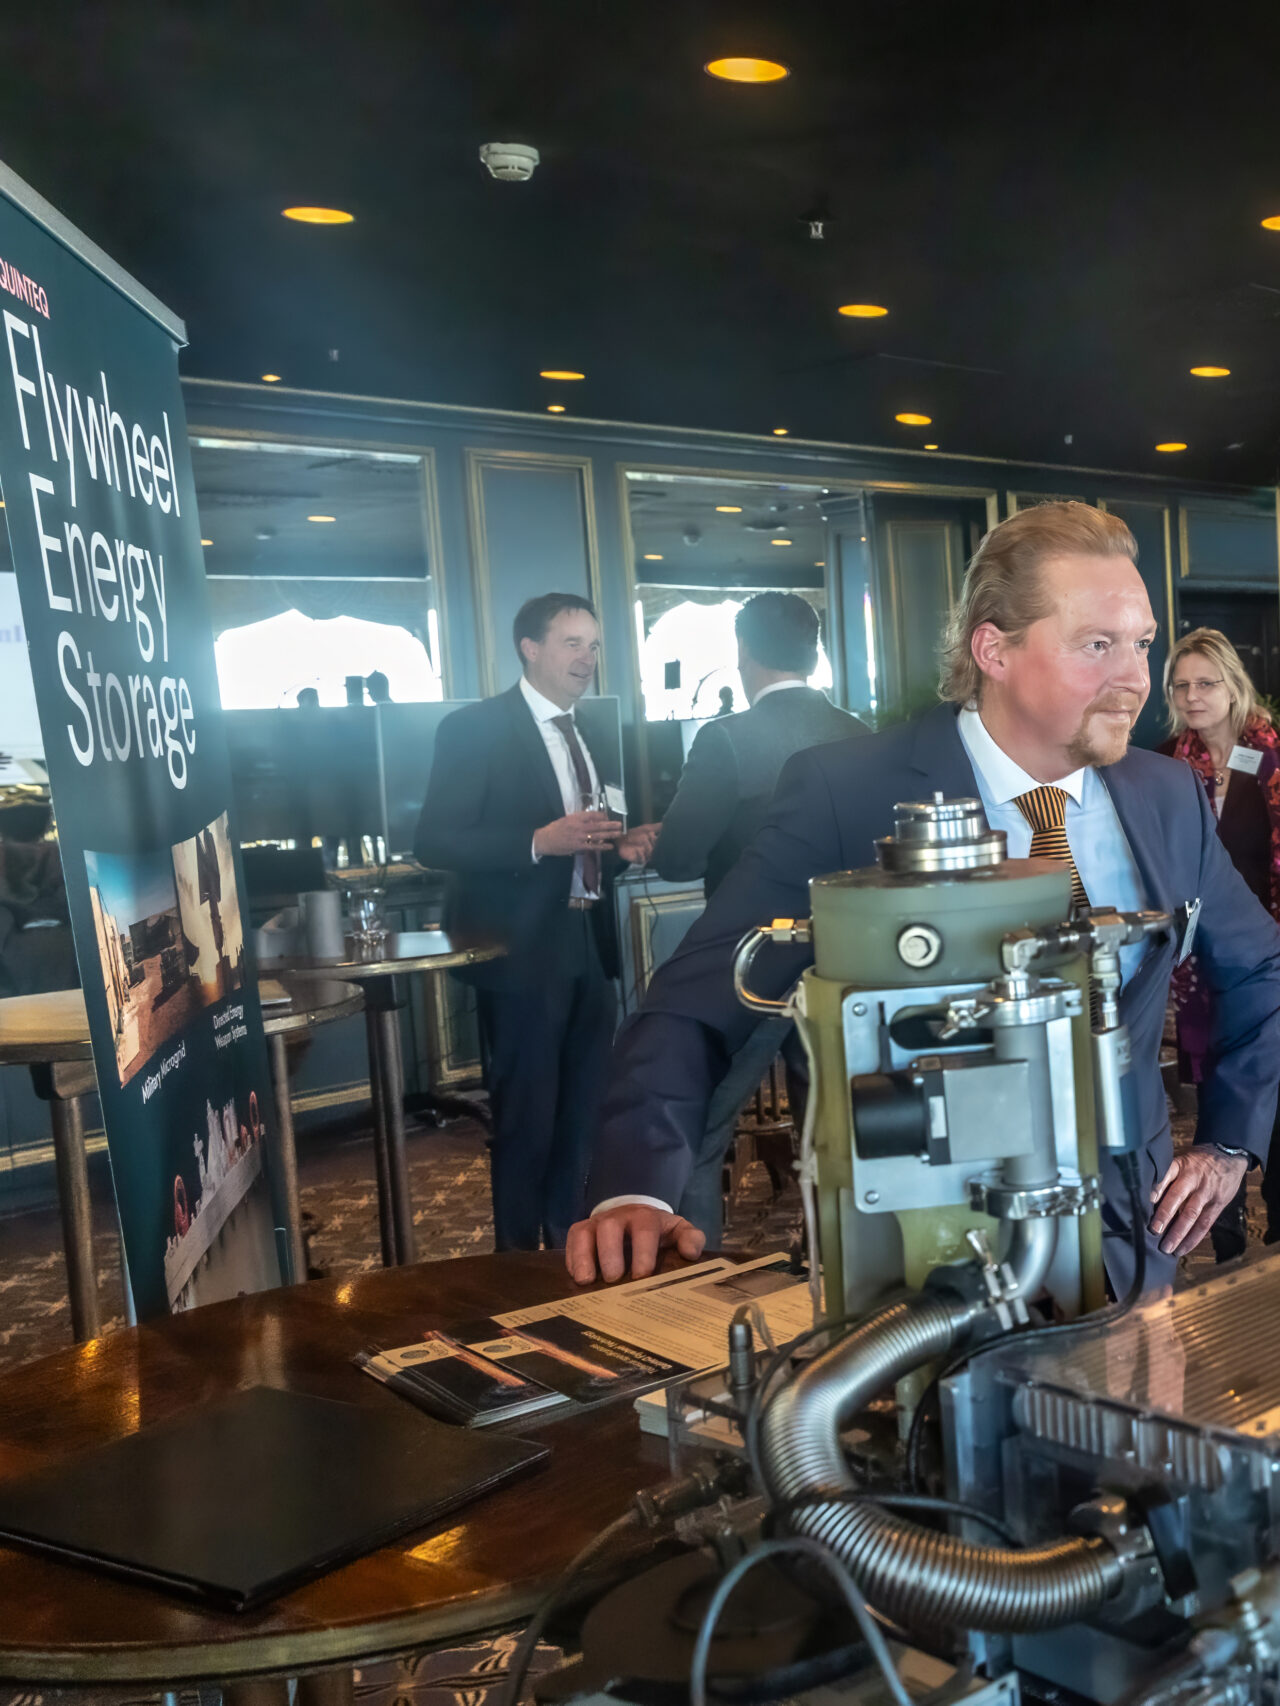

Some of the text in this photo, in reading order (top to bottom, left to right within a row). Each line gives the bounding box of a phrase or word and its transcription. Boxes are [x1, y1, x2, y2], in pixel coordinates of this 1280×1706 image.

[0, 256, 50, 320] QUINTEQ
[3, 309, 181, 518] Flywheel
[29, 472, 168, 663] Energy
[57, 631, 196, 790] Storage
[141, 1039, 186, 1105] Military Microgrid
